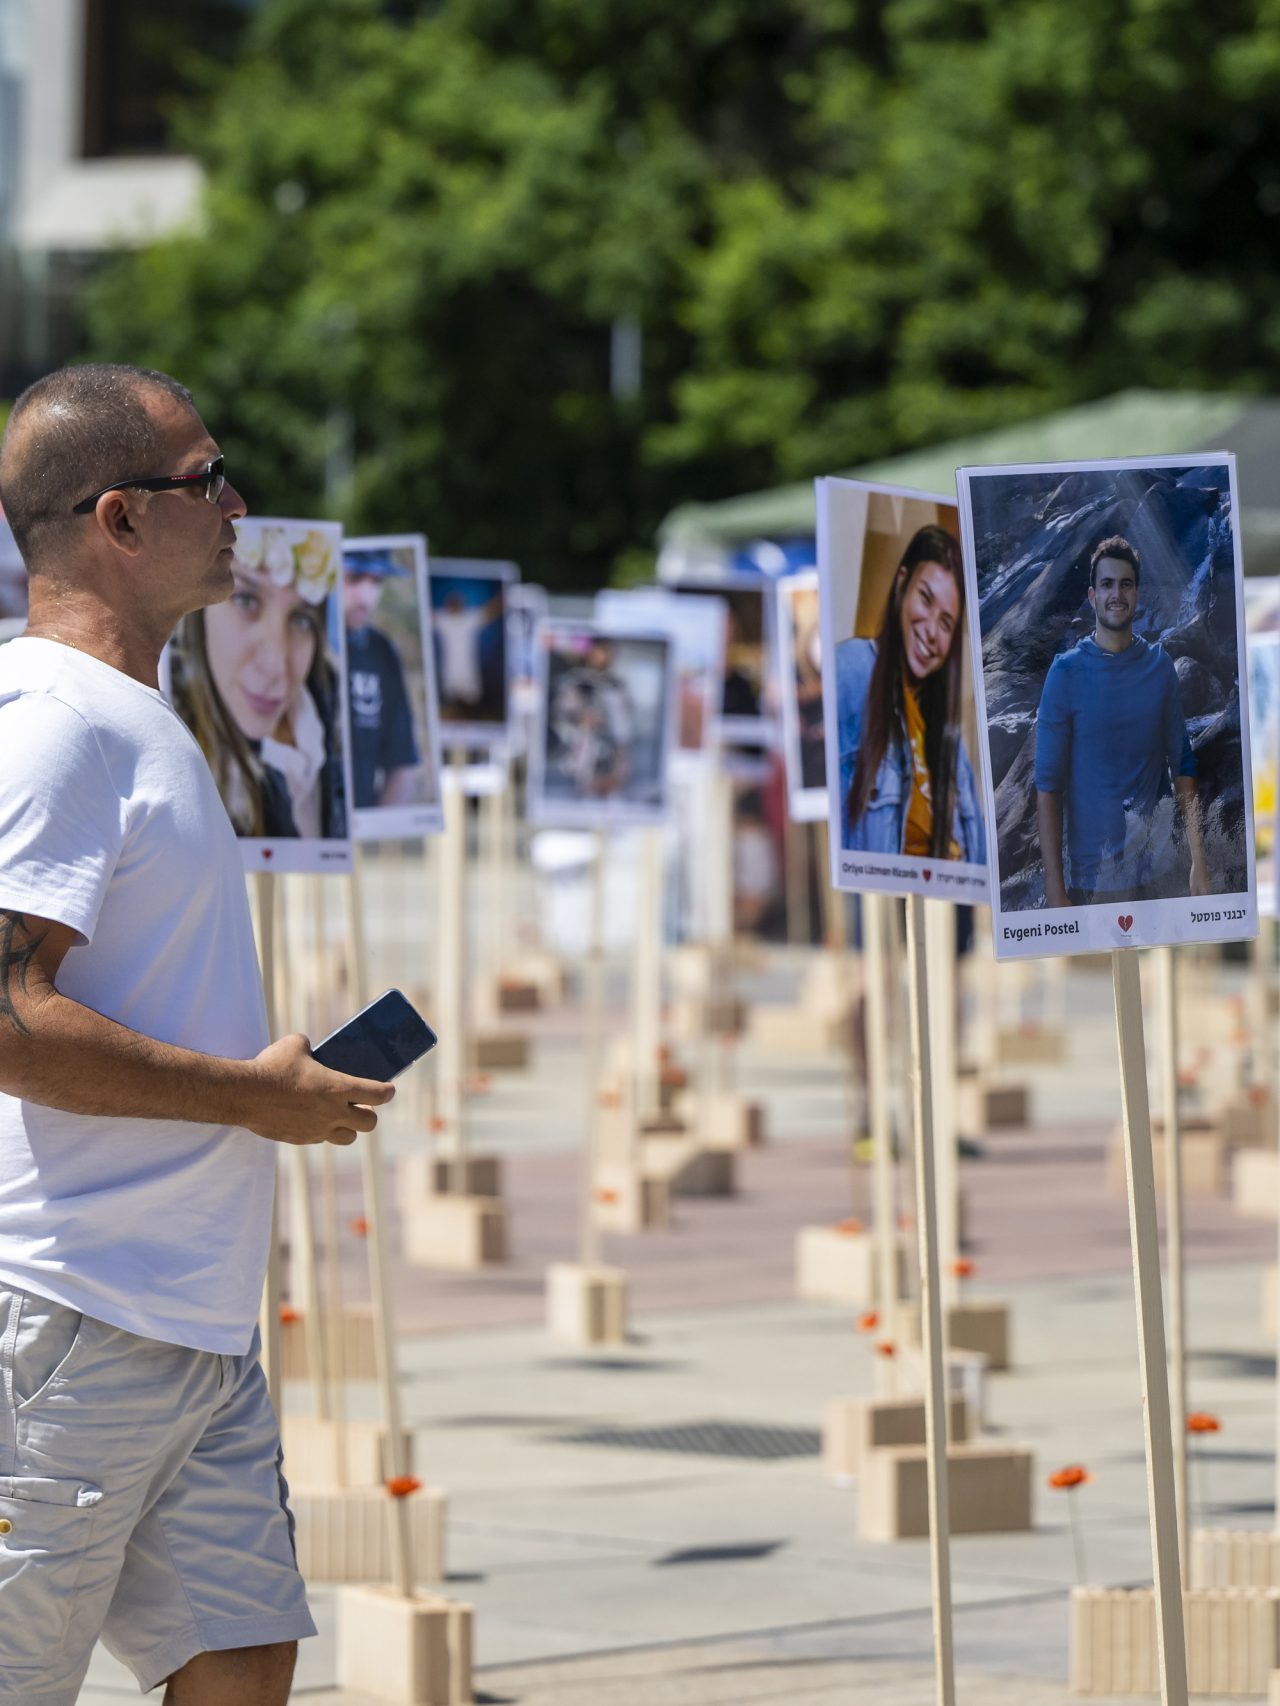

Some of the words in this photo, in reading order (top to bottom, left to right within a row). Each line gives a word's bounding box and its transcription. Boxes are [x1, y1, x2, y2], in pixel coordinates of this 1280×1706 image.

[1190, 911, 1221, 923] פוסטל
[1223, 909, 1246, 920] יבגני
[1003, 923, 1042, 942] Evgeni
[1044, 920, 1080, 936] Postel
